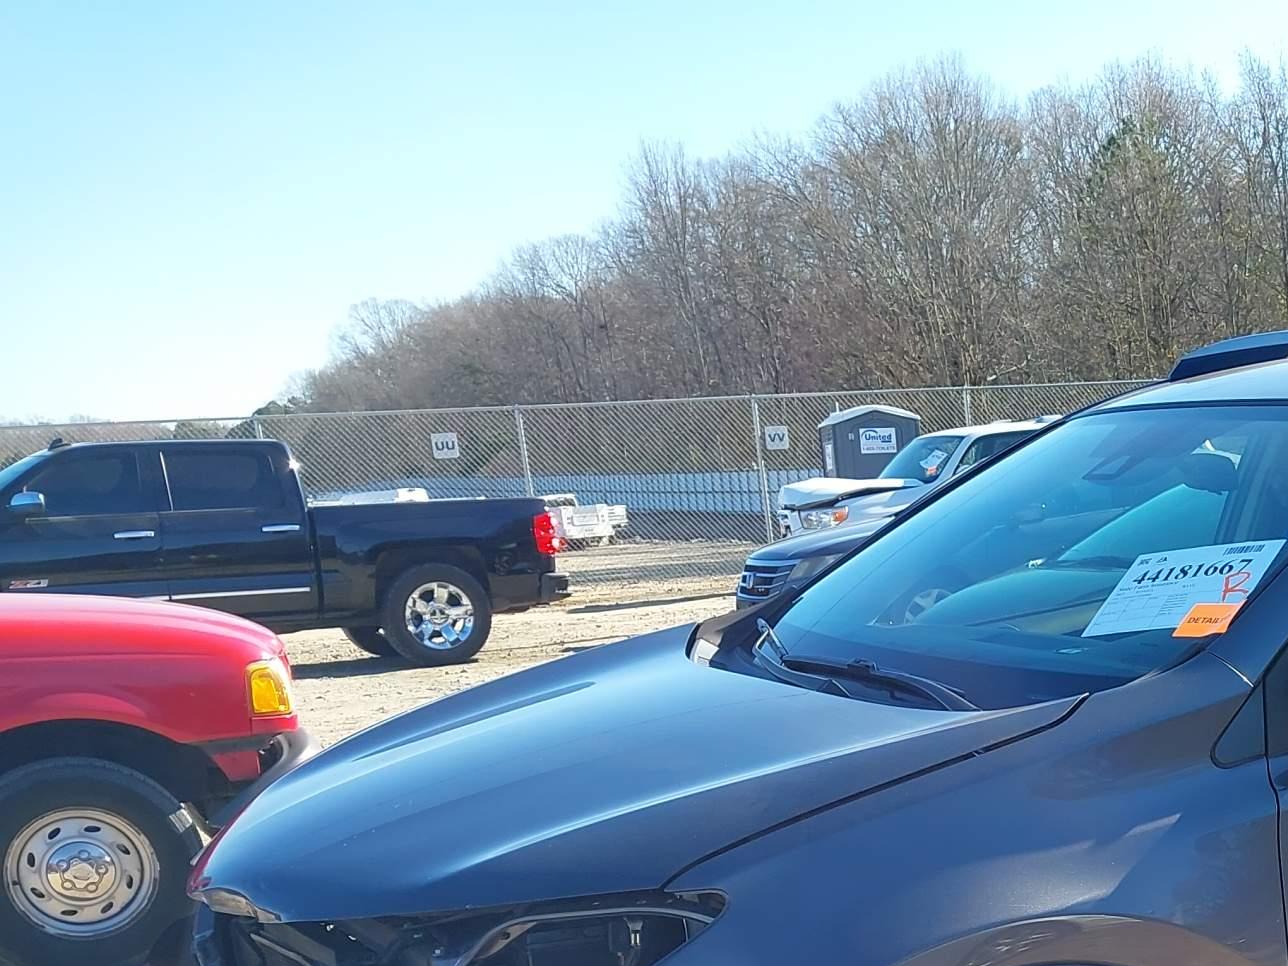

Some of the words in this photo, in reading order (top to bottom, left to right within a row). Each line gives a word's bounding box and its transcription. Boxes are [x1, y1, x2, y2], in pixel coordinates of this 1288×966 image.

[435, 440, 455, 451] UU
[864, 432, 892, 442] United
[1133, 558, 1254, 585] 44181667
[1222, 572, 1251, 602] R
